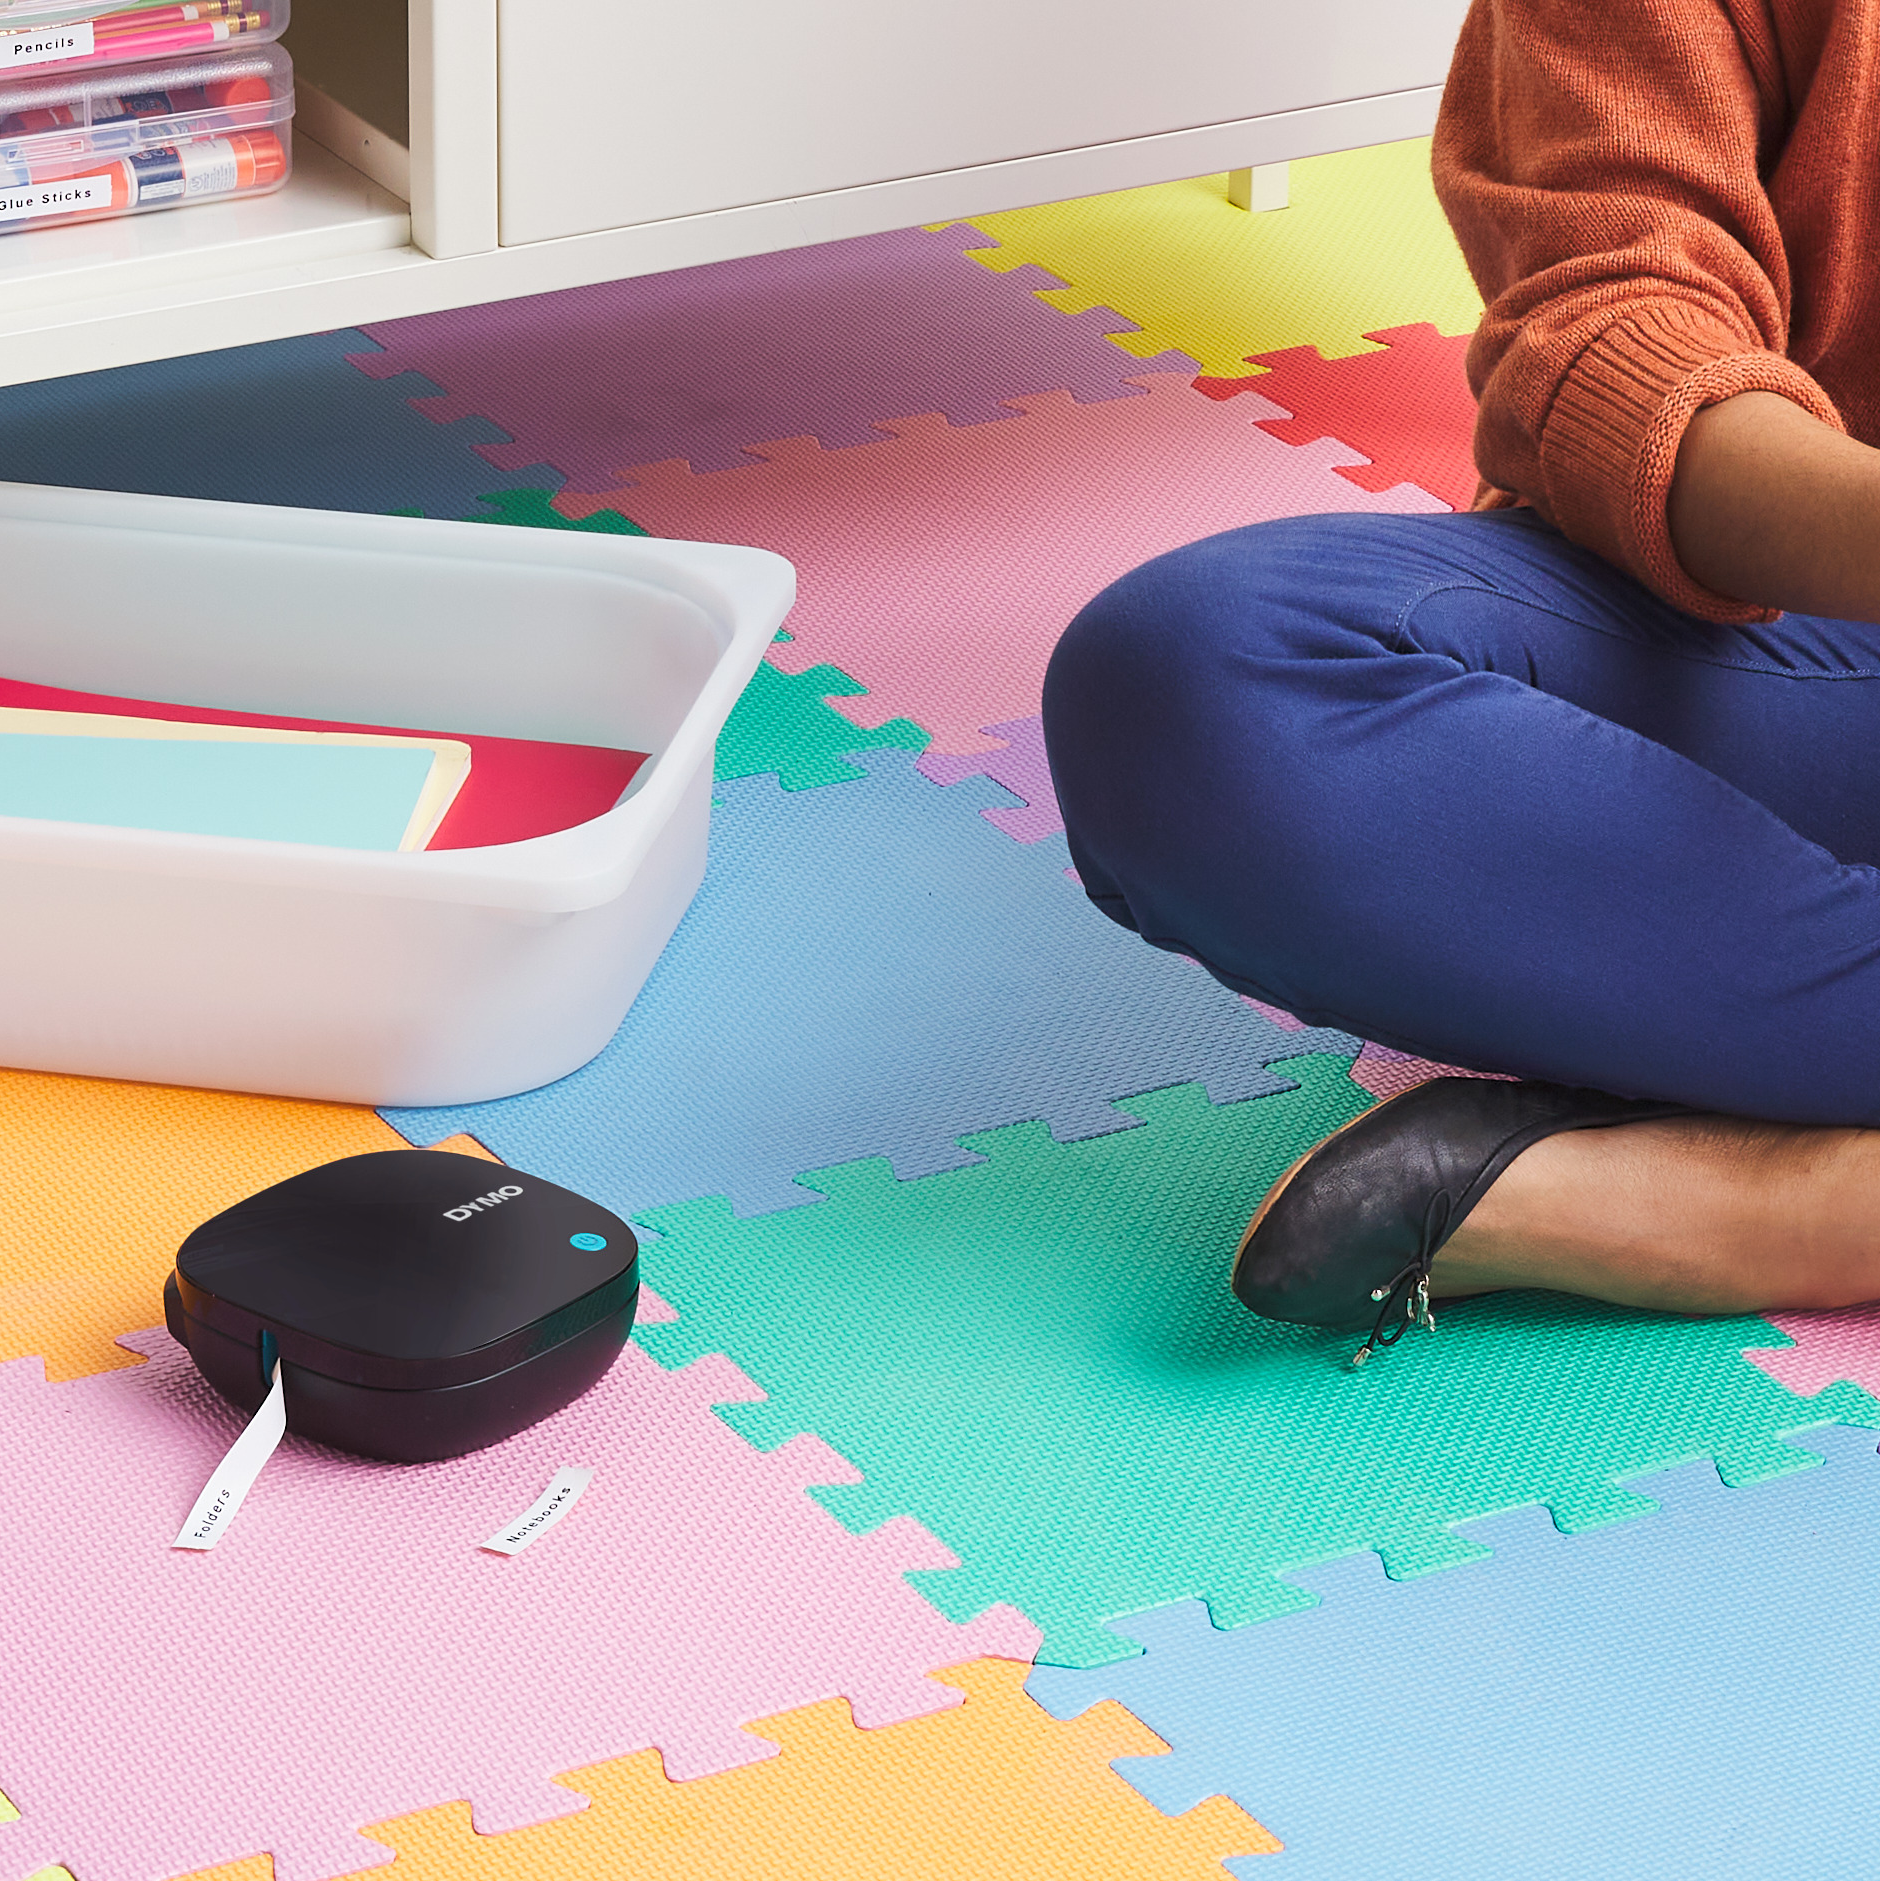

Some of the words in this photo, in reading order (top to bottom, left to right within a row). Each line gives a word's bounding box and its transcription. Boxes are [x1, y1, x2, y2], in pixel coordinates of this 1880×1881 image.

[13, 37, 75, 56] Pencils
[41, 189, 92, 205] Sticks
[442, 1184, 525, 1223] DYMO
[193, 1488, 231, 1539] Folders
[505, 1486, 572, 1544] Notebooks
